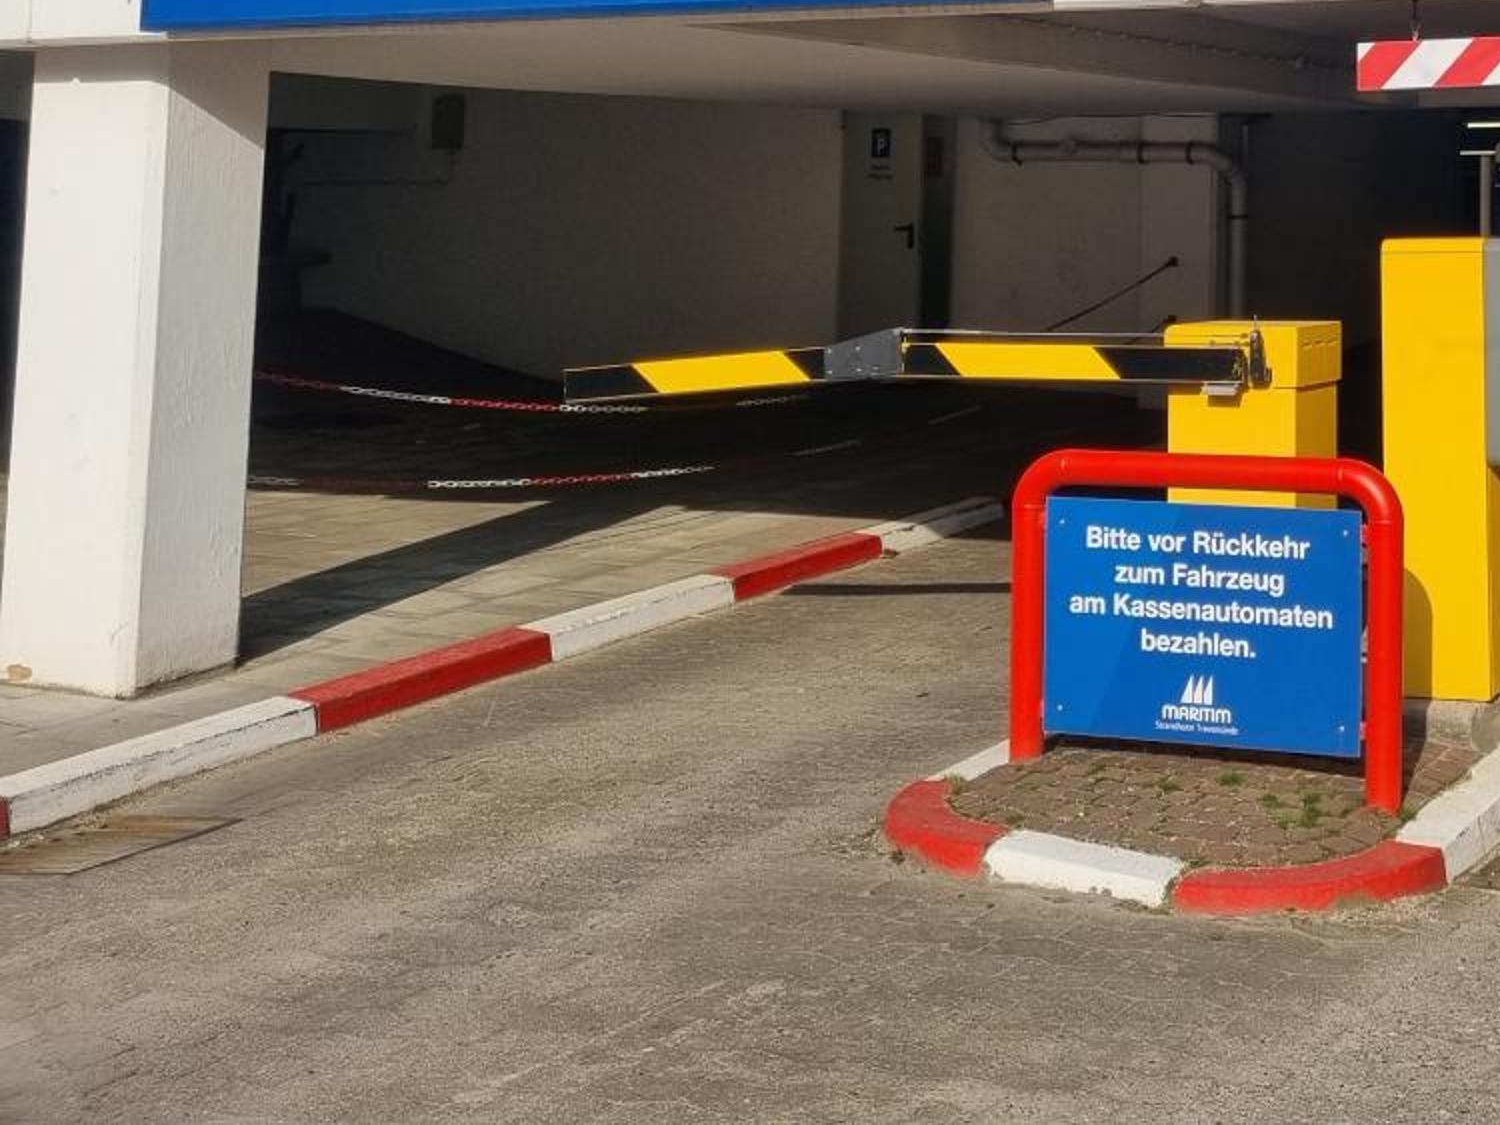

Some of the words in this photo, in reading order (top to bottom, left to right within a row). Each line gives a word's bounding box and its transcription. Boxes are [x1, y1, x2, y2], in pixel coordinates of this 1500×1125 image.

[1086, 525, 1141, 550] Bitte
[1148, 535, 1187, 553] vor
[1193, 531, 1311, 560] Rückkehr
[1114, 565, 1165, 585] zum
[1172, 563, 1285, 597] Fahrzeug
[1069, 595, 1105, 615] am
[1113, 593, 1333, 629] Kassenautomaten
[1141, 629, 1256, 657] bezahlen.
